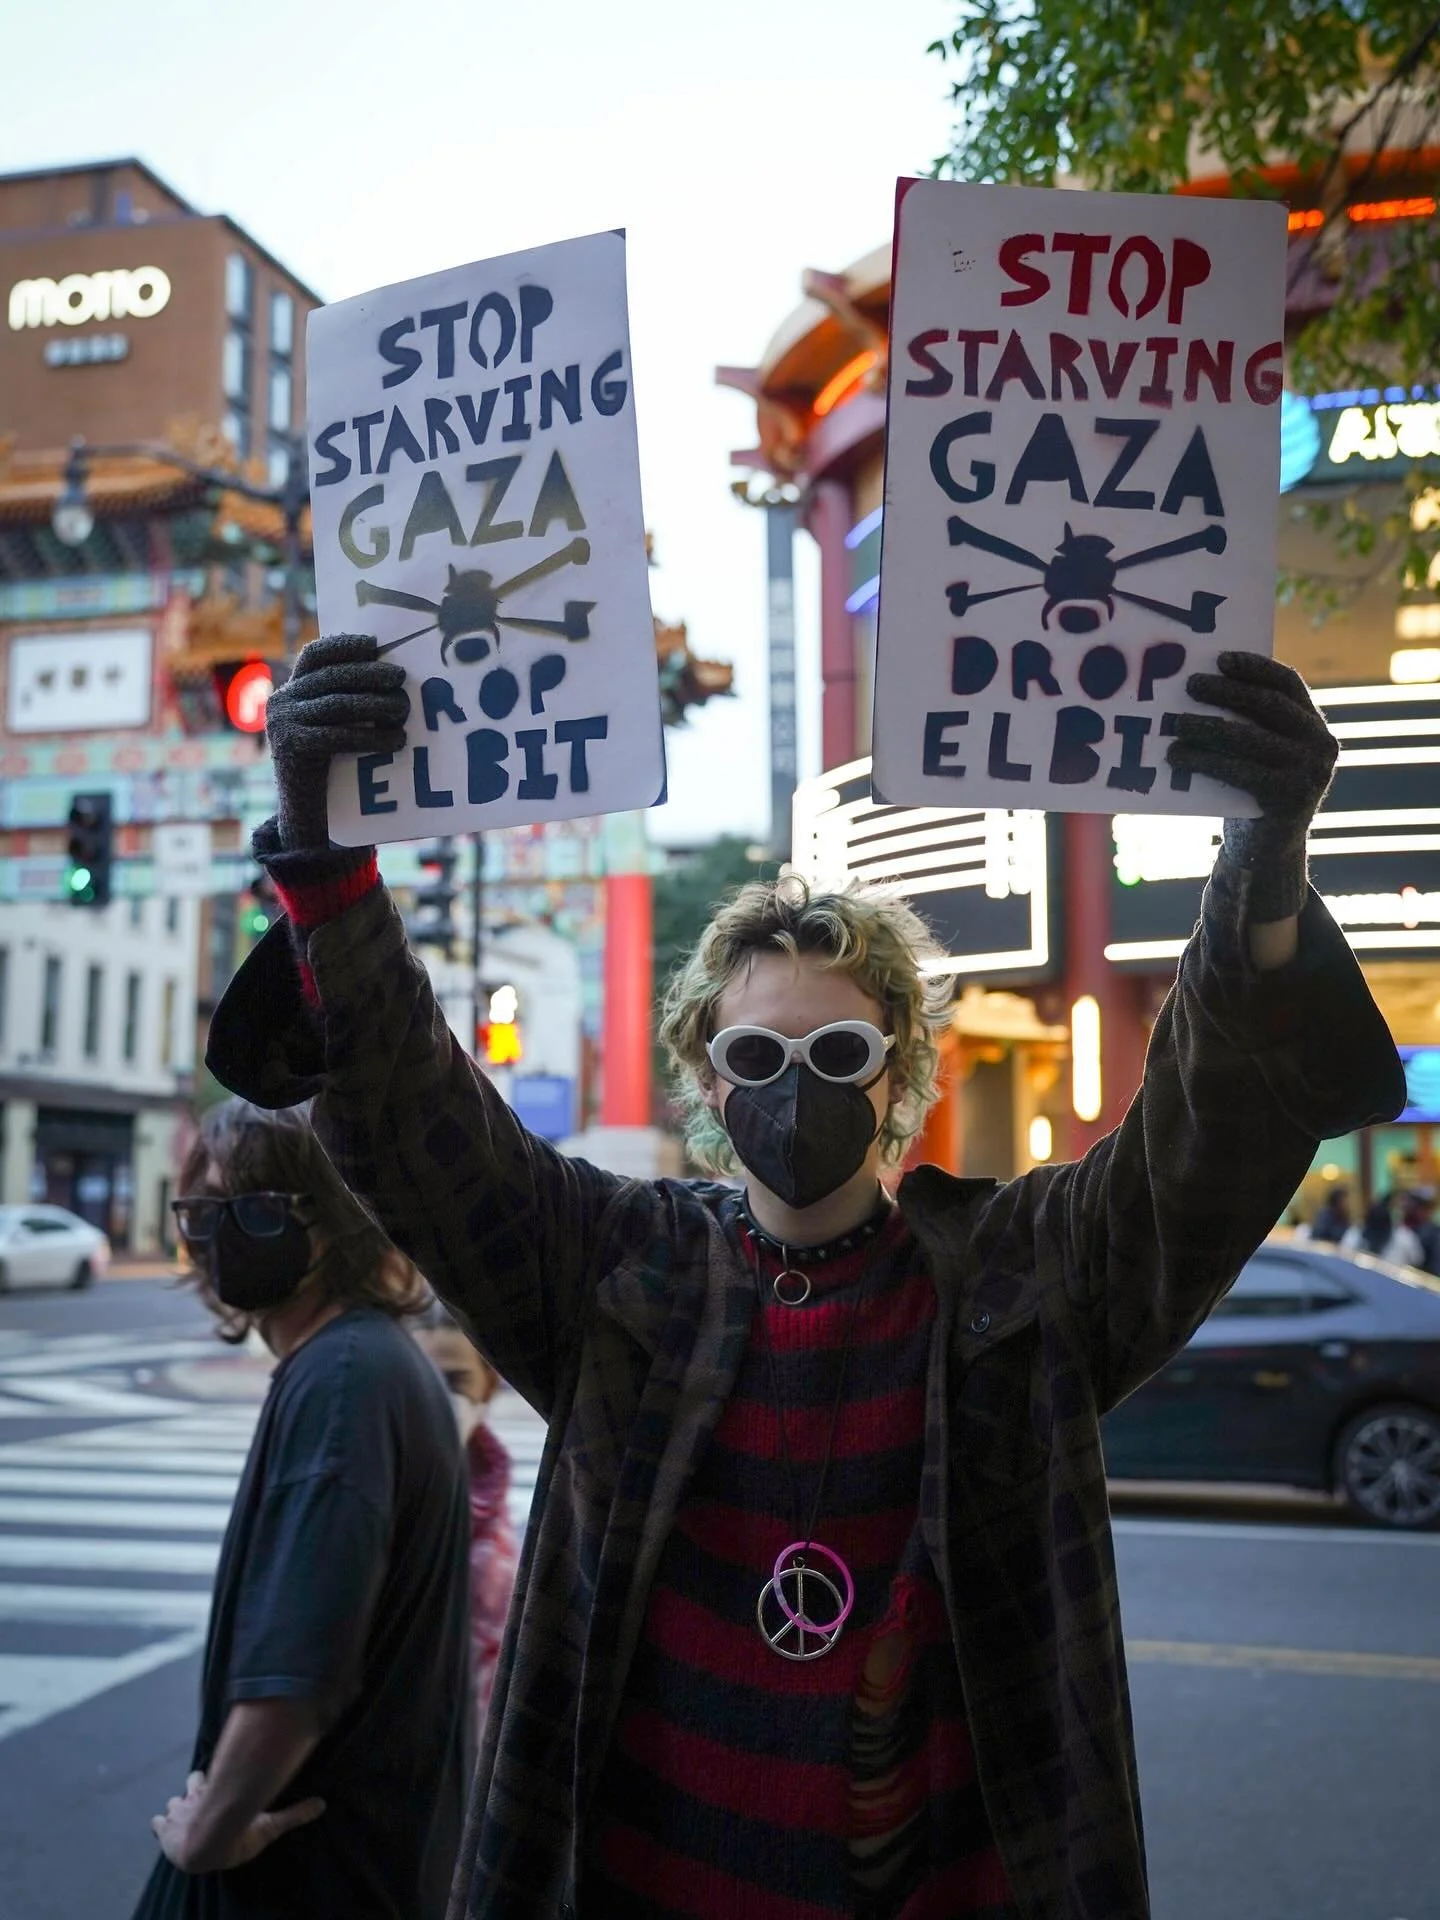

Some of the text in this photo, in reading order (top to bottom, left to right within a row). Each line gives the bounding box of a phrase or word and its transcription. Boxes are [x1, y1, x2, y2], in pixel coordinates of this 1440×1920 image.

[999, 232, 1212, 325] STOP
[378, 284, 554, 389] STOP
[905, 329, 1283, 409] STARVING
[315, 350, 628, 487] STARVING
[929, 411, 1226, 518] GAZA
[338, 448, 587, 570] GAZA
[405, 654, 566, 732] ROP
[951, 636, 1187, 702] DROP
[357, 715, 608, 816] ELBIT
